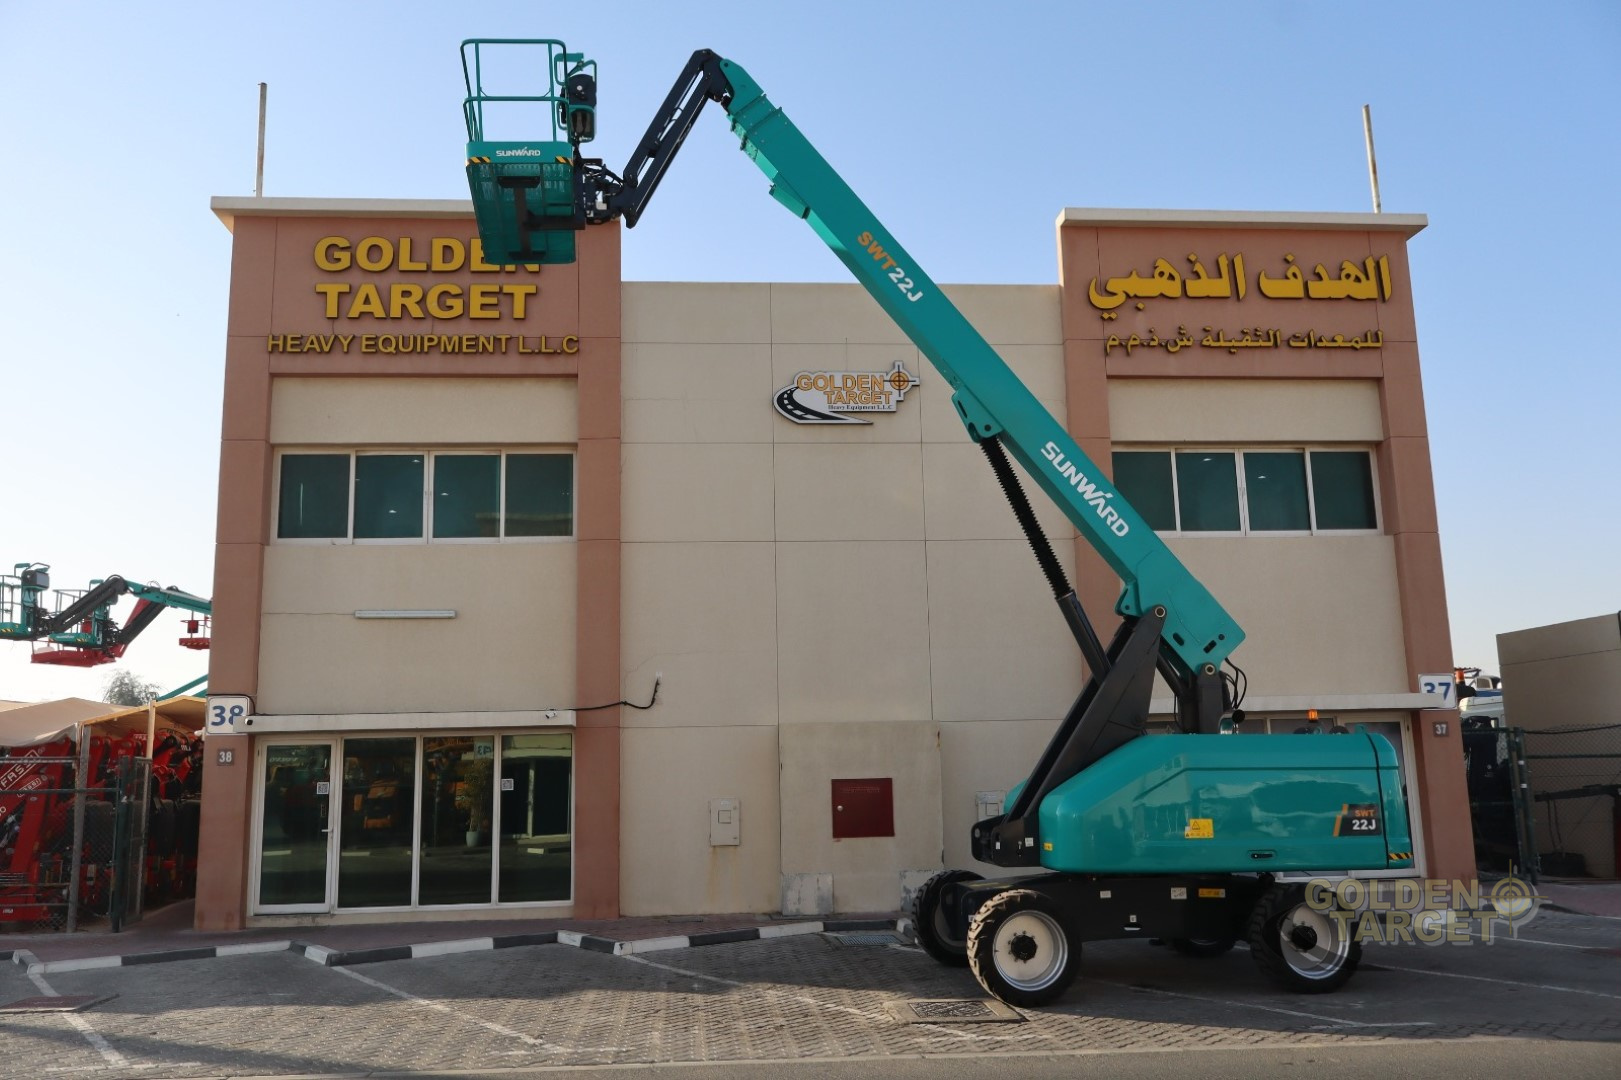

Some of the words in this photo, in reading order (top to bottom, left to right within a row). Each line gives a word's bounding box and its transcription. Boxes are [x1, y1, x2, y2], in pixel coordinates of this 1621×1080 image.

[496, 146, 541, 157] SUNWARD
[313, 236, 541, 273] GOLDE
[1088, 252, 1248, 321] الذهبي
[1258, 252, 1393, 303] الهدف
[315, 283, 538, 320] TARGET
[267, 333, 354, 355] HEAVY
[361, 333, 511, 355] EQUIPMENT
[518, 334, 580, 355] L.L.C
[1201, 325, 1282, 355] الثقيلة
[1288, 328, 1385, 350] للمعدات
[796, 374, 885, 392] GOLDEN
[823, 390, 893, 405] TARGET
[1040, 441, 1130, 537] SUNWARD
[210, 704, 244, 727] 38
[1435, 724, 1447, 735] 37
[219, 751, 232, 762] 38
[1352, 819, 1376, 830] 22J
